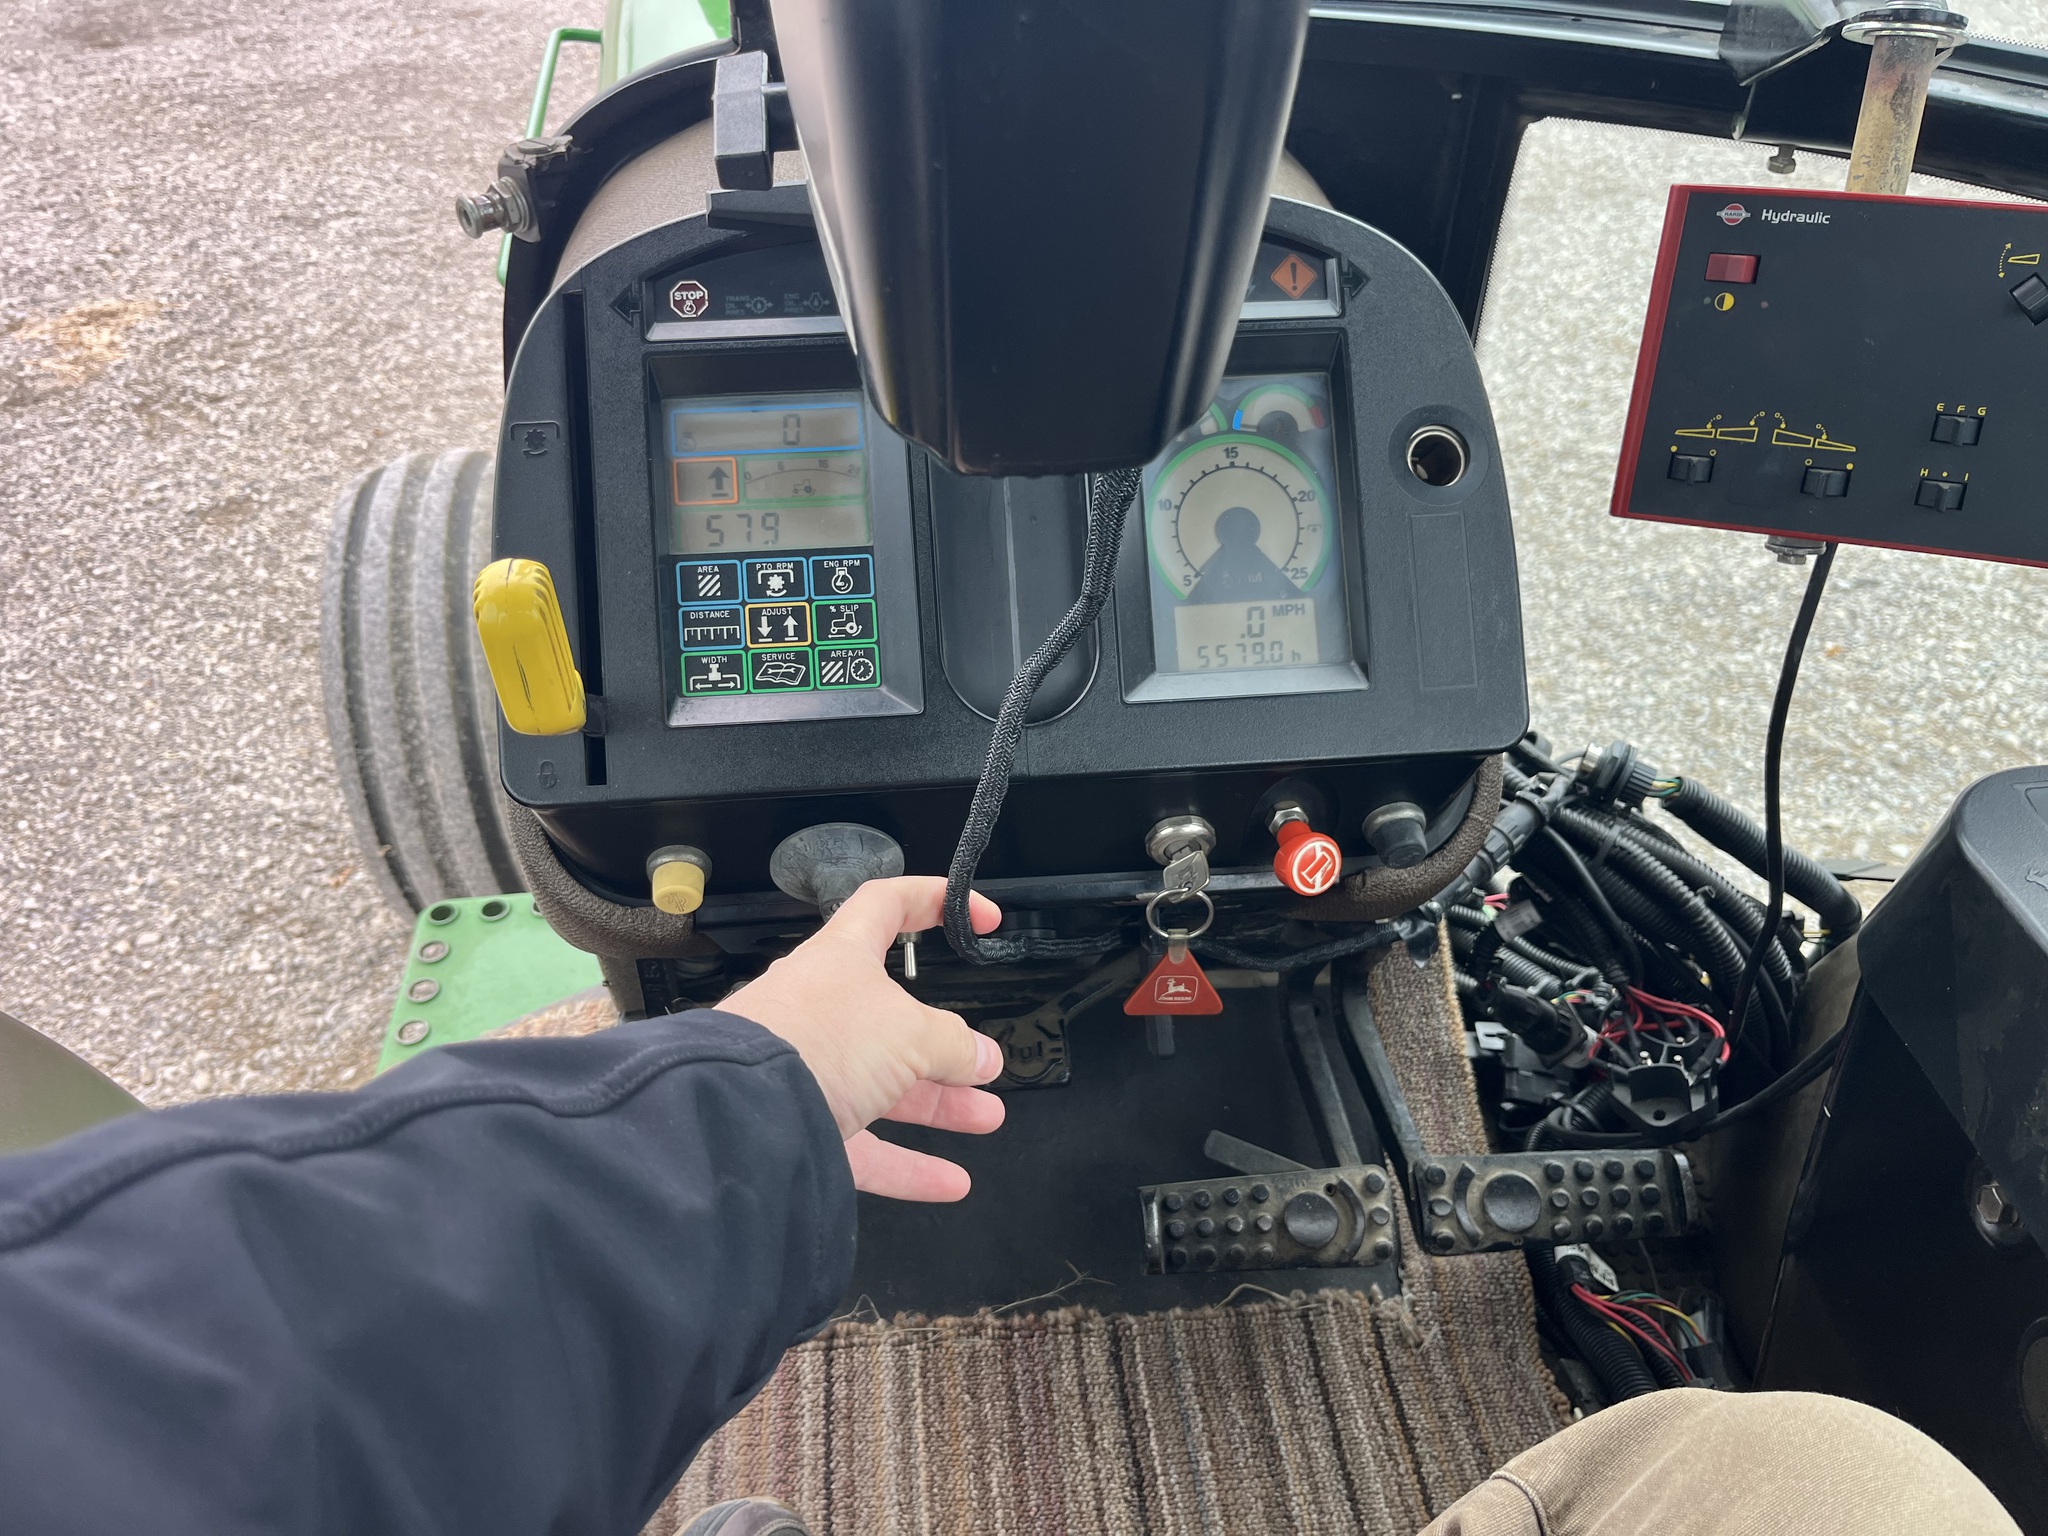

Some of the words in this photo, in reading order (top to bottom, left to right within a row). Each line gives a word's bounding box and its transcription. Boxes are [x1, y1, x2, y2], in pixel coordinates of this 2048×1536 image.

[1761, 208, 1831, 224] Hydraulic
[674, 291, 704, 301] STOP
[1936, 402, 1945, 412] E
[1957, 405, 1966, 414] F
[1977, 407, 1987, 416] G
[783, 413, 801, 446] 0
[1223, 447, 1239, 459] 15
[1297, 490, 1316, 503] 20
[1158, 499, 1173, 511] 10
[756, 563, 774, 571] PTO
[776, 562, 794, 570] RPM
[823, 559, 840, 568] ENG
[843, 558, 861, 567] RPM
[697, 565, 720, 573] AREA
[1290, 567, 1309, 580] 25
[1183, 574, 1192, 587] 5
[762, 607, 793, 616] ADJUST
[840, 604, 859, 612] SLIP
[1271, 604, 1306, 617] MPH
[690, 610, 731, 619] DISTANCE
[761, 652, 796, 661] SERVICE
[831, 649, 864, 658] AREA/H
[701, 655, 728, 664] WIDTH
